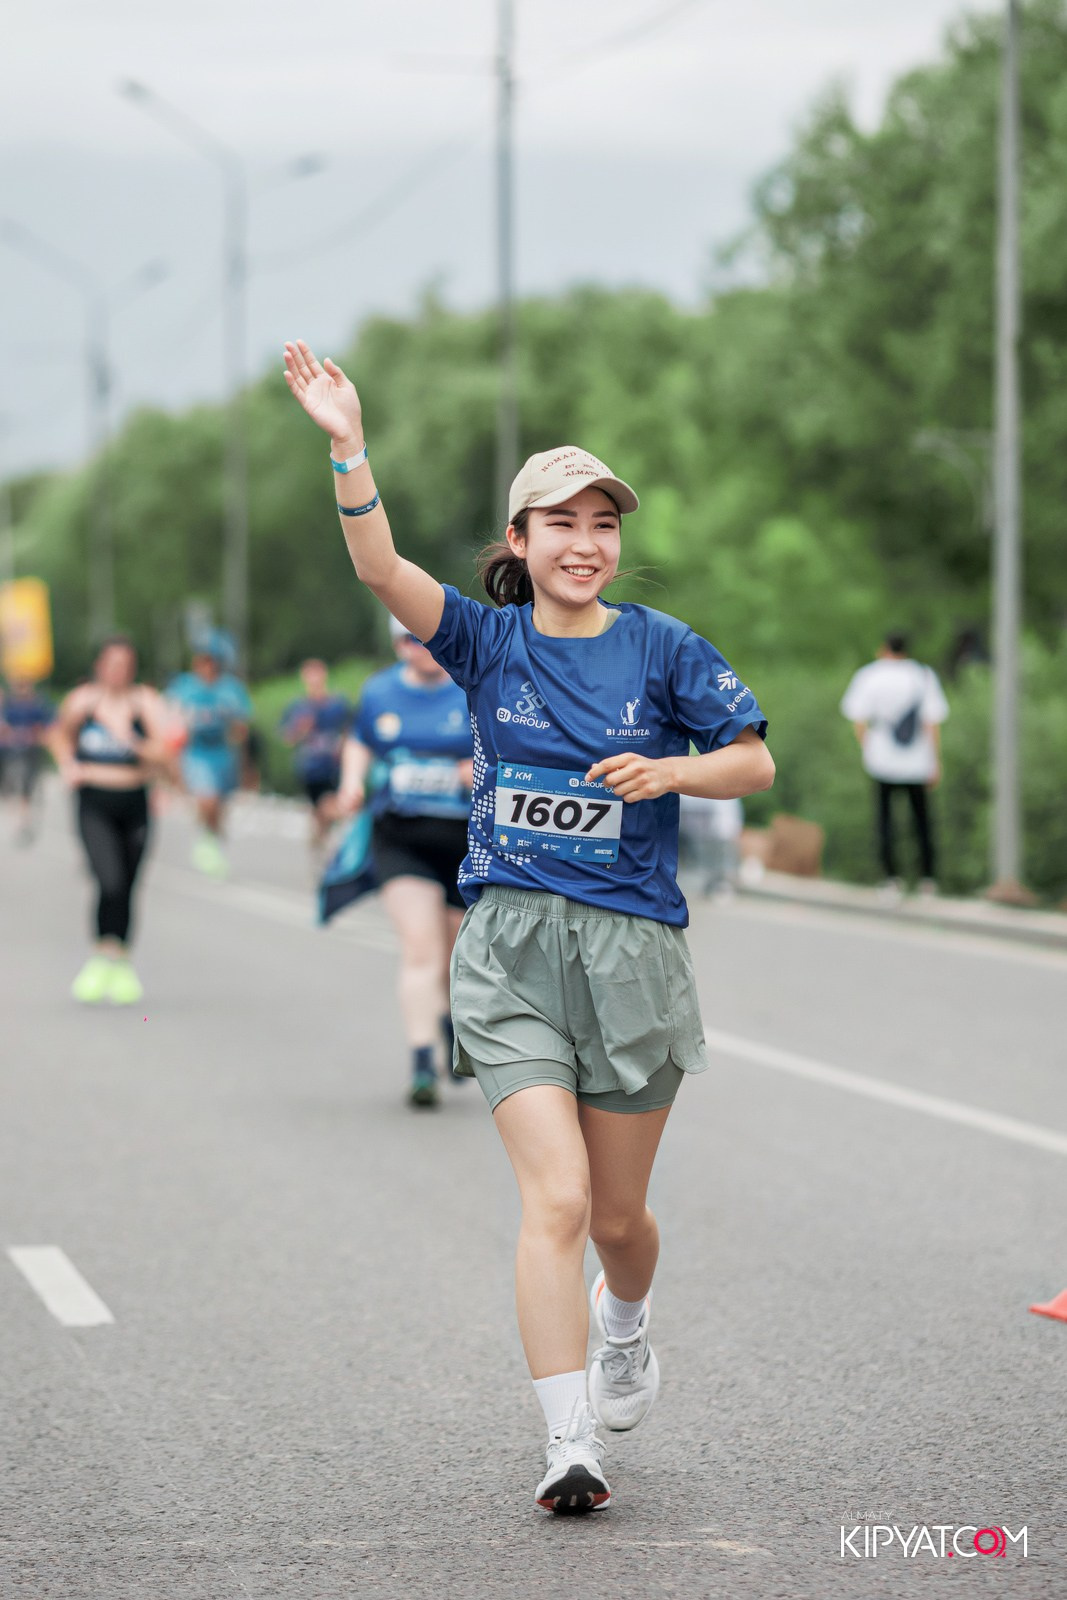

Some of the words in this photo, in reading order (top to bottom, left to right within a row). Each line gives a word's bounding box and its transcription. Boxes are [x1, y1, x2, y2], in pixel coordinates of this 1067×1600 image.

[541, 451, 577, 473] NOMAD
[512, 714, 550, 730] GROUP
[606, 728, 616, 736] BI
[503, 767, 513, 779] 5
[515, 771, 532, 782] KM
[580, 780, 604, 789] GROUP
[510, 794, 612, 833] 1607
